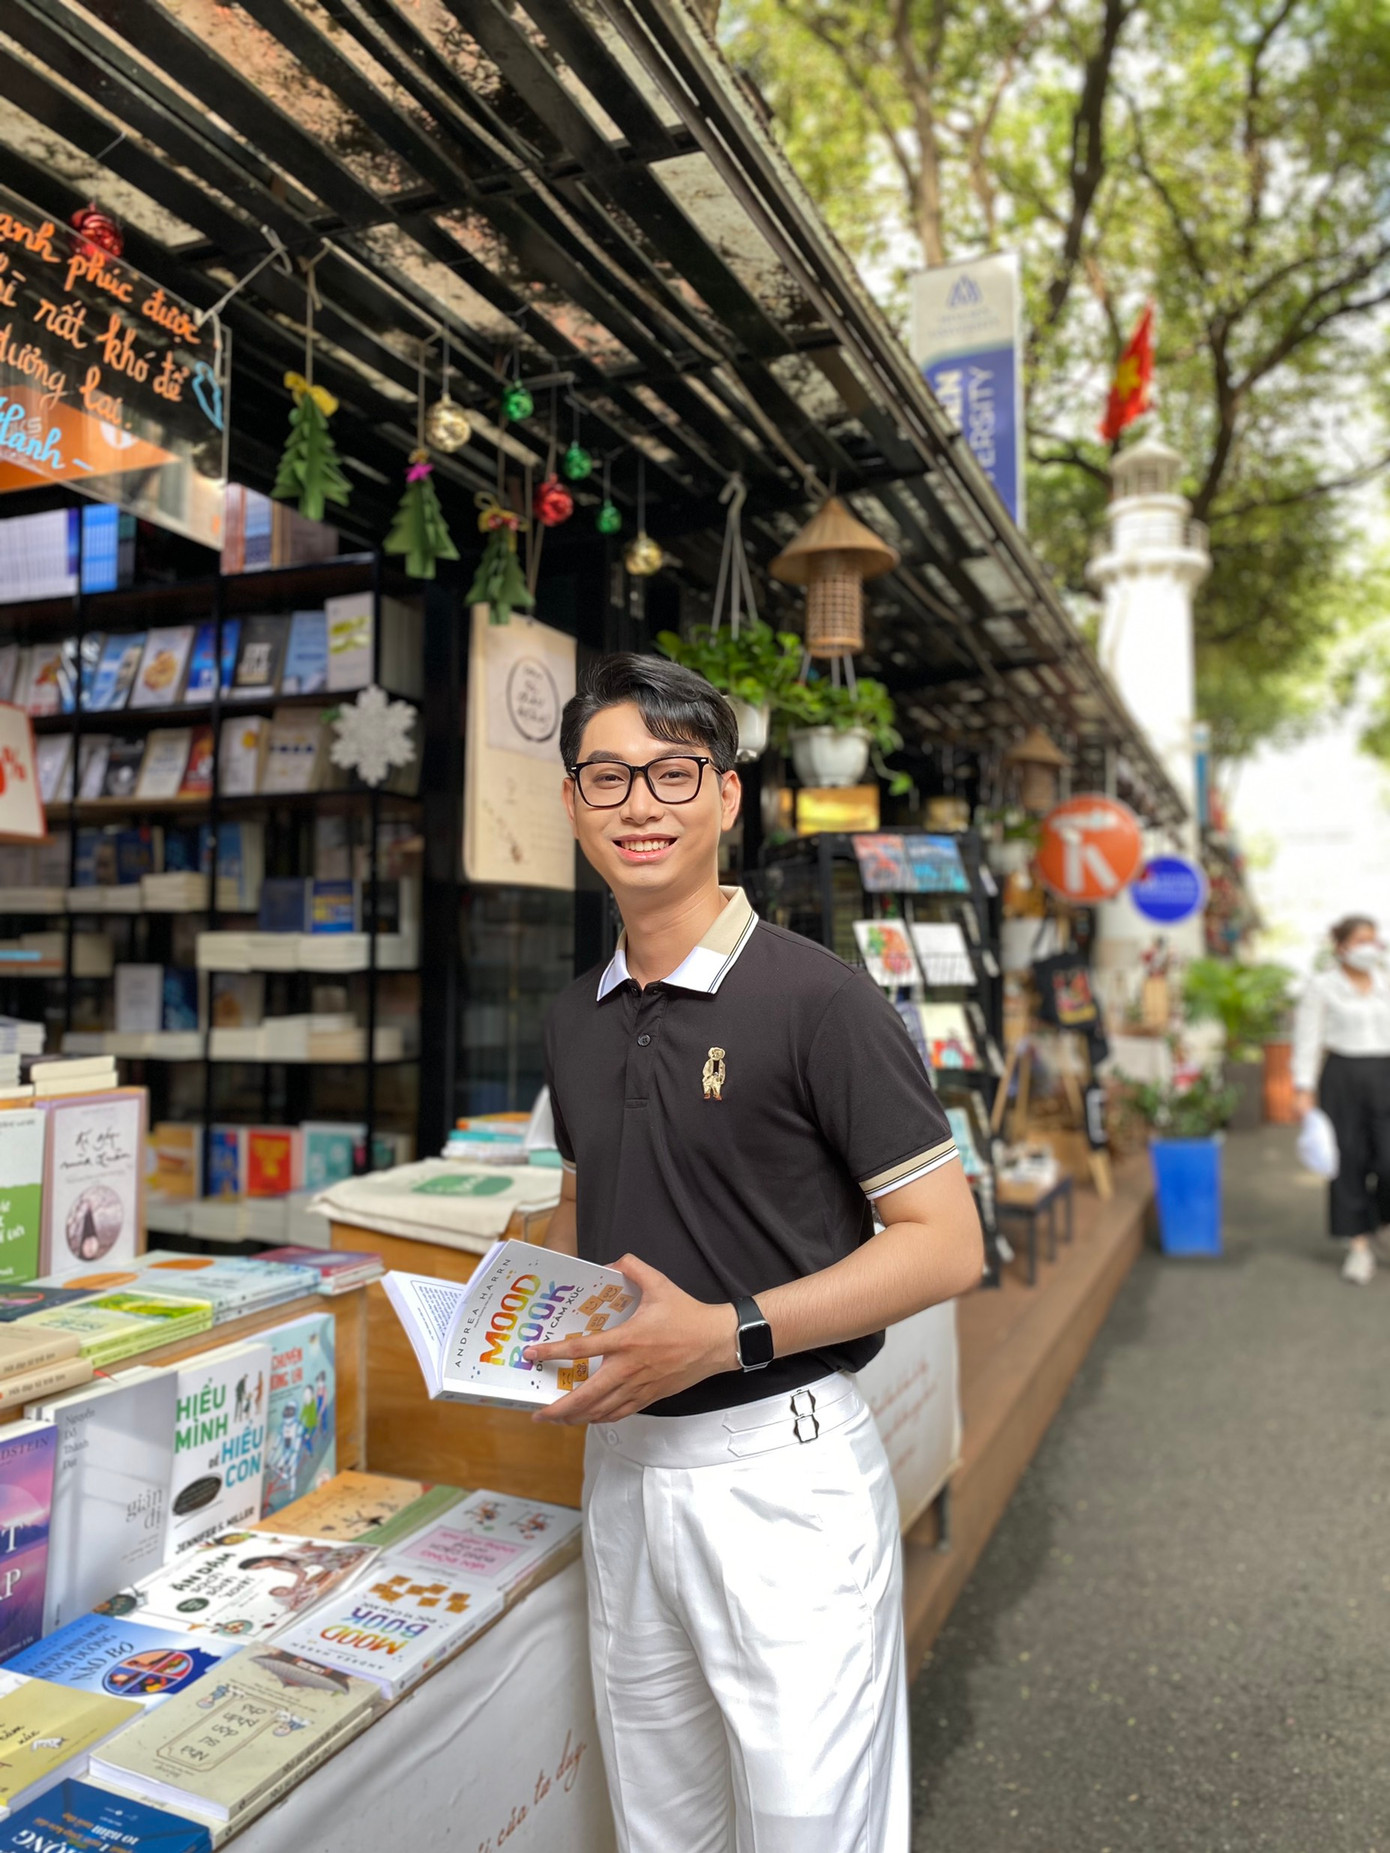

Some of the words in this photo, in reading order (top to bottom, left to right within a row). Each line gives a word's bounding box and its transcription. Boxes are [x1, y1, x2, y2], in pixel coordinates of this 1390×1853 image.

[0, 213, 61, 264] ạnh
[63, 249, 134, 304] phúc
[141, 287, 202, 345] được
[95, 313, 156, 383] khó
[152, 351, 191, 402] để
[455, 1308, 479, 1367] ANDREA
[480, 1259, 511, 1300] HARRN
[480, 1274, 541, 1366] MOOD
[509, 1281, 575, 1371] BOOK
[543, 1331, 555, 1342] VỊ
[551, 1306, 568, 1328] CẢM
[567, 1286, 585, 1305] XÚC
[176, 1378, 226, 1422] HIỂU
[0, 1436, 49, 1461] DSTEIN
[175, 1414, 228, 1453] MÌNH
[221, 1420, 263, 1465] HIỂU
[225, 1453, 261, 1488] CON
[0, 1522, 24, 1553] T
[176, 1527, 217, 1554] JENNIFER
[226, 1507, 254, 1529] MILLER
[0, 1567, 22, 1601] P
[320, 1624, 411, 1656] MOOD
[341, 1606, 430, 1640] BOOK
